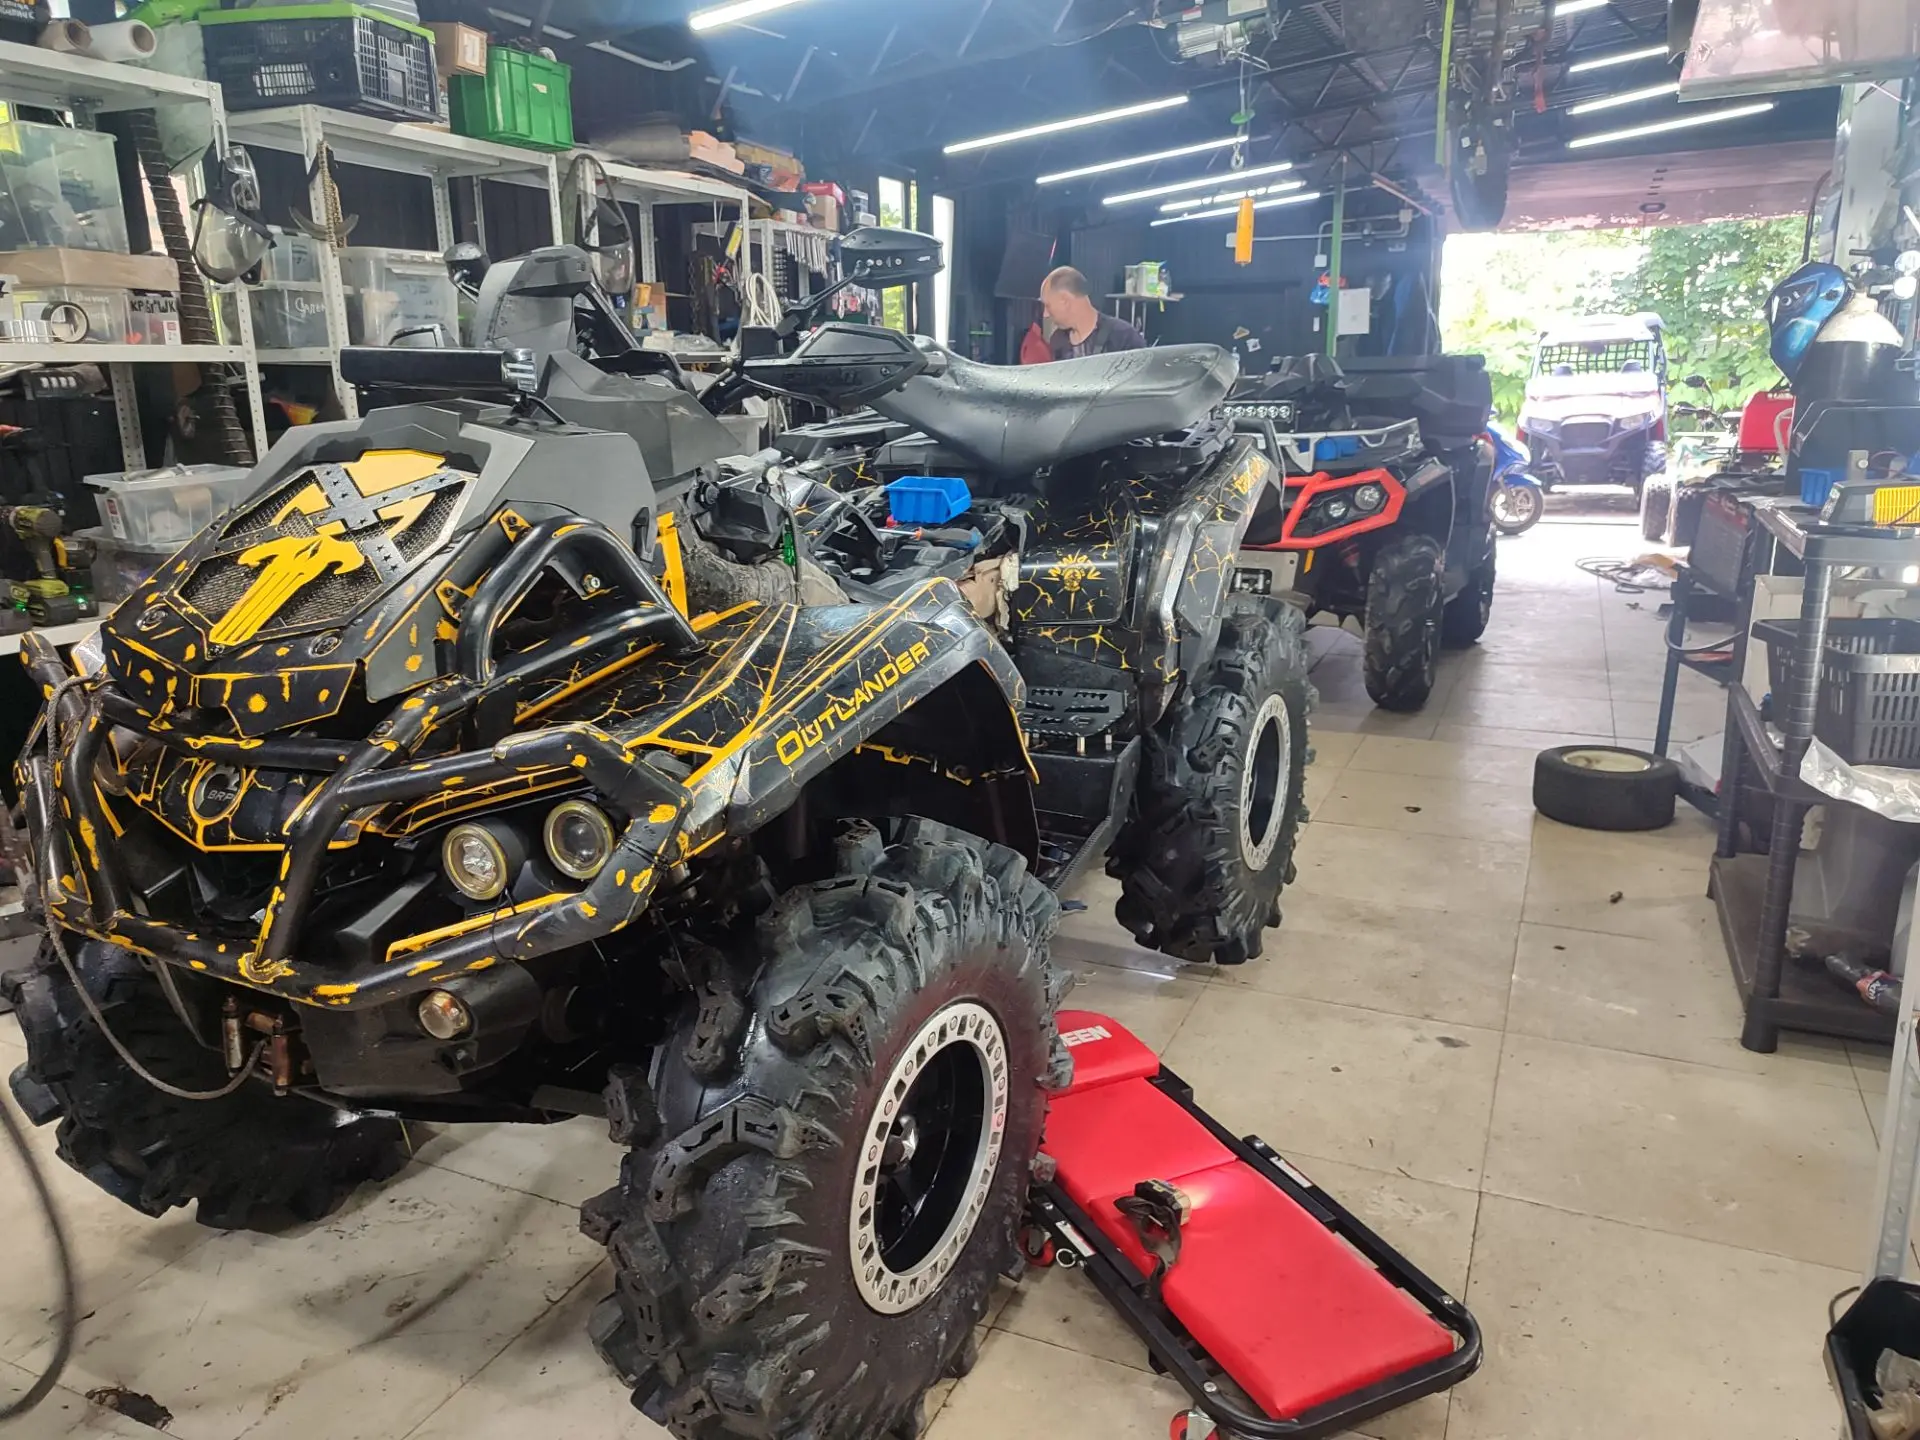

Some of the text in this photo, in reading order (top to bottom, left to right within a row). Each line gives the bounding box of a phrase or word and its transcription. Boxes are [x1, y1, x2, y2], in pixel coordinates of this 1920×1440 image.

[776, 641, 931, 766] OUTLANDER
[207, 790, 235, 801] BRP
[1059, 1025, 1112, 1047] EEN
